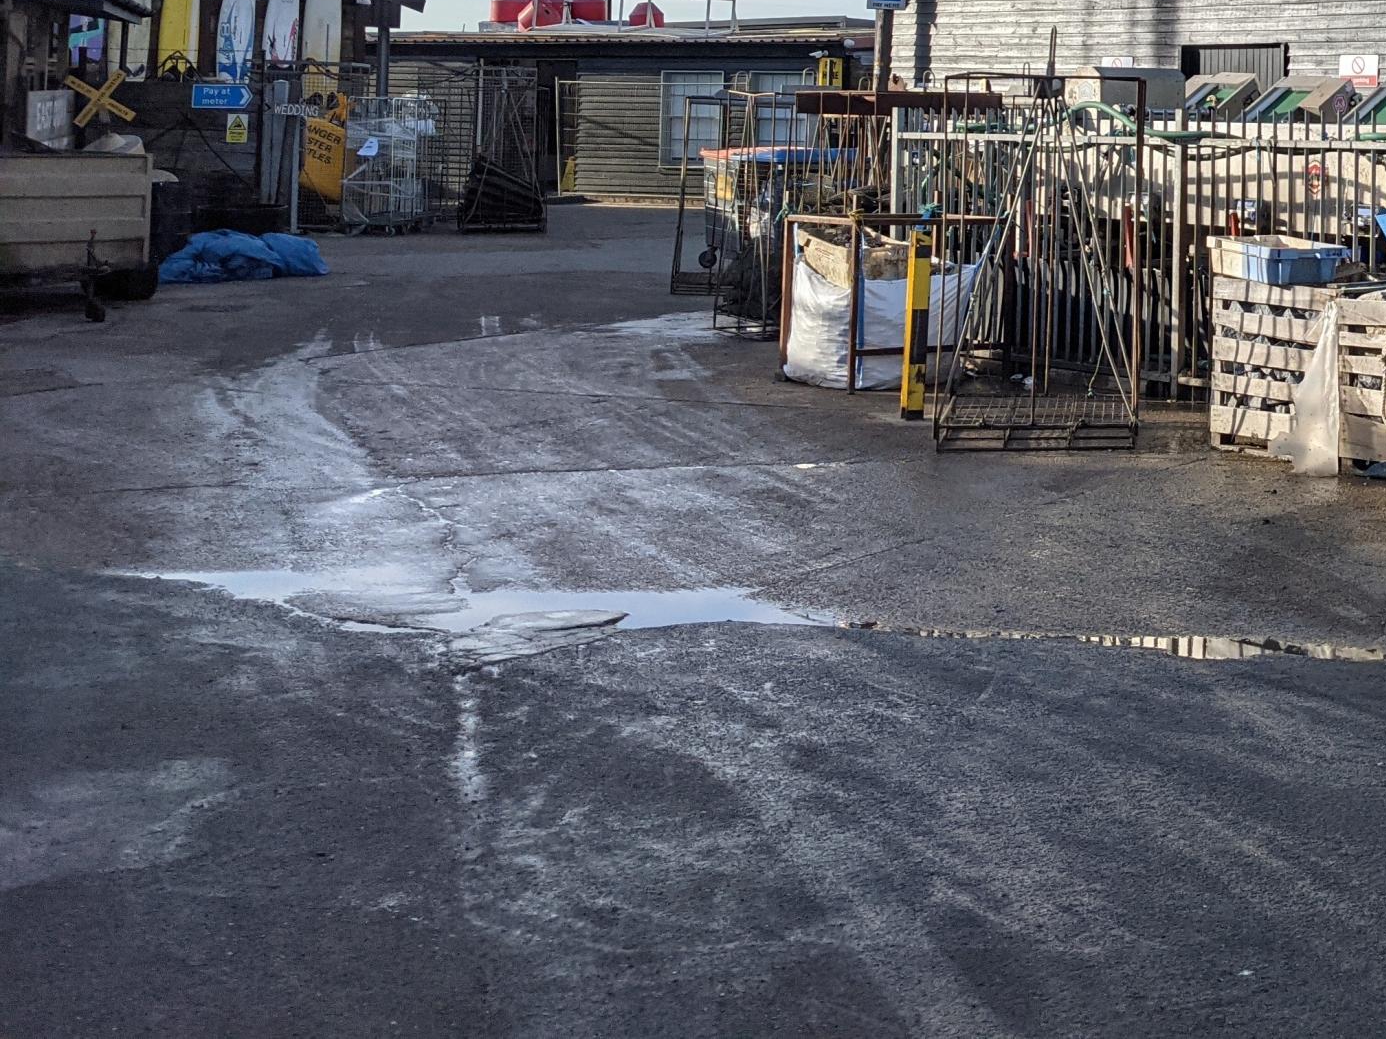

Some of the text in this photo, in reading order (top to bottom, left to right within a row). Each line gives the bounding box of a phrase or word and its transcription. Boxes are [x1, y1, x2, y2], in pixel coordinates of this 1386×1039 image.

[824, 60, 837, 70] PY
[203, 87, 231, 97] Pay at
[201, 97, 229, 105] meter
[274, 103, 319, 117] WEDDING
[306, 124, 342, 145] ANGER
[306, 136, 333, 154] STER
[306, 148, 332, 165] TLES
